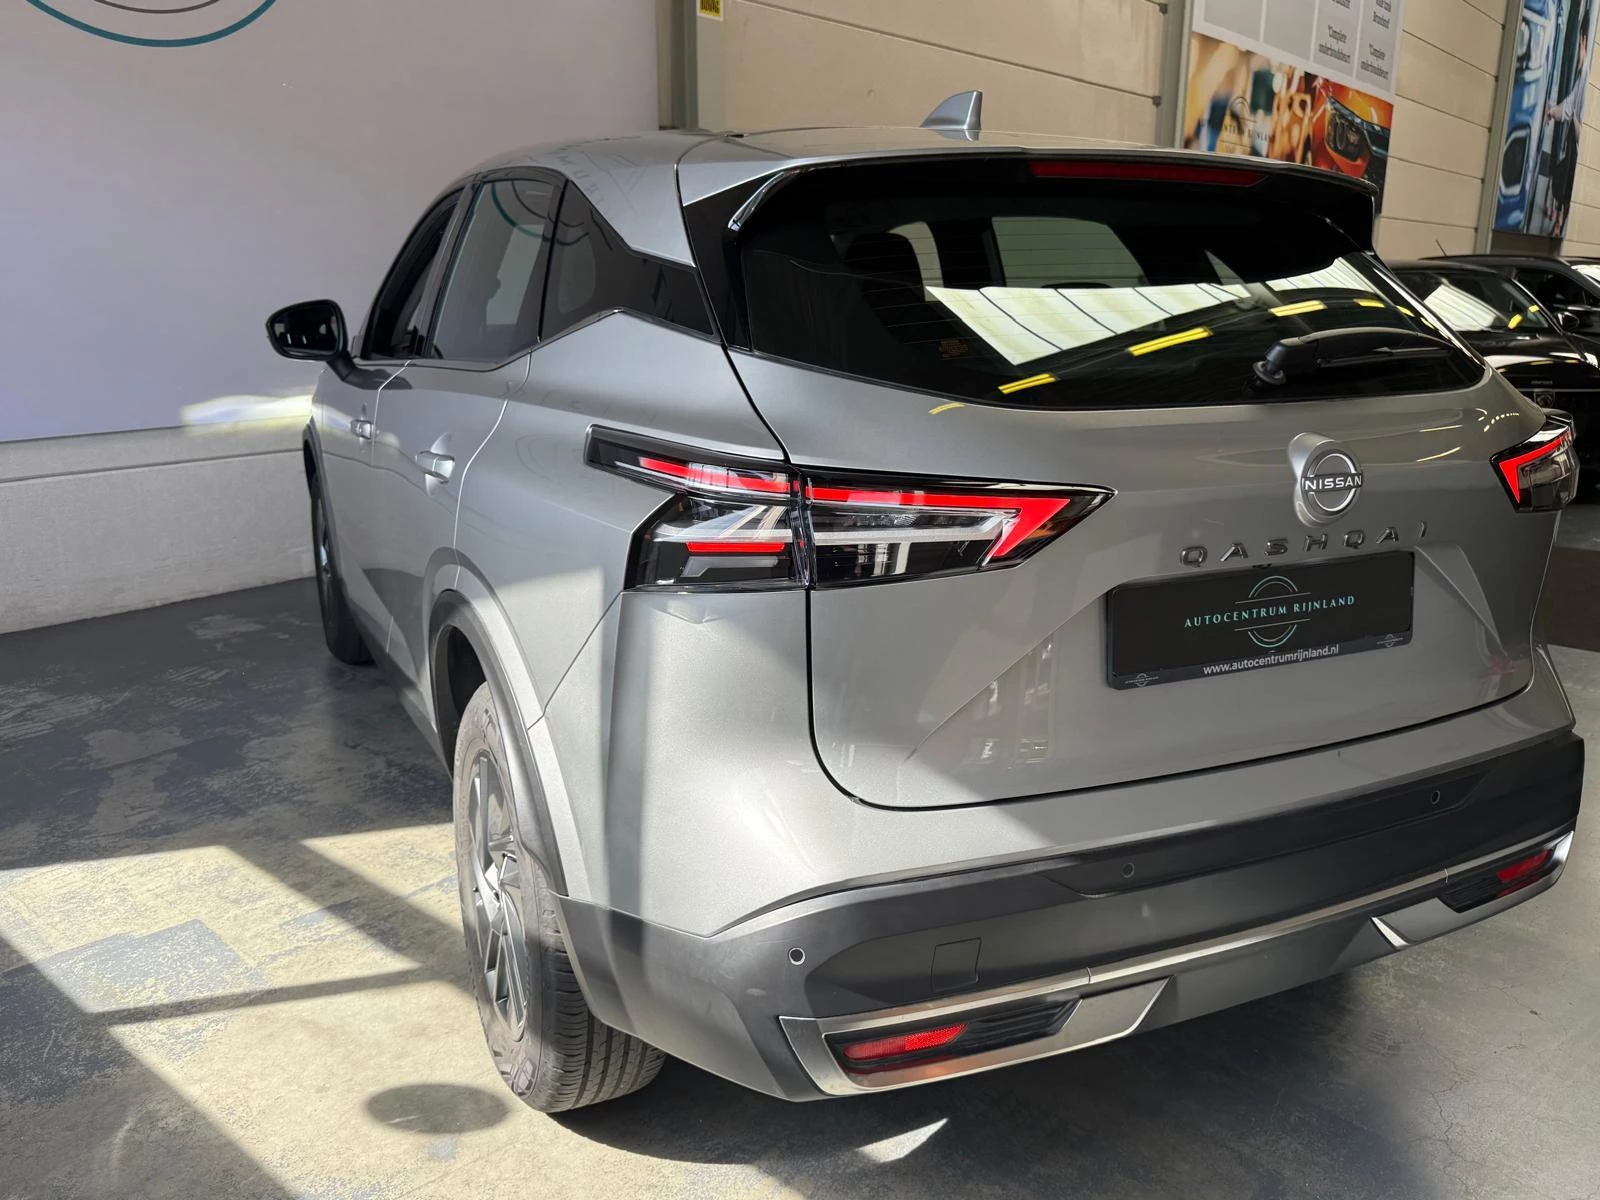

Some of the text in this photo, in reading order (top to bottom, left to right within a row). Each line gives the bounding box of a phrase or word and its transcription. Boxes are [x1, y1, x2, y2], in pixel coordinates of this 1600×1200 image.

[1304, 475, 1362, 491] NISSAN
[1179, 520, 1428, 568] QASHQAI
[1184, 595, 1355, 628] AUTOCENTRUM RIJNLAND
[1203, 644, 1339, 675] www.autocentrumrijnland.nl
